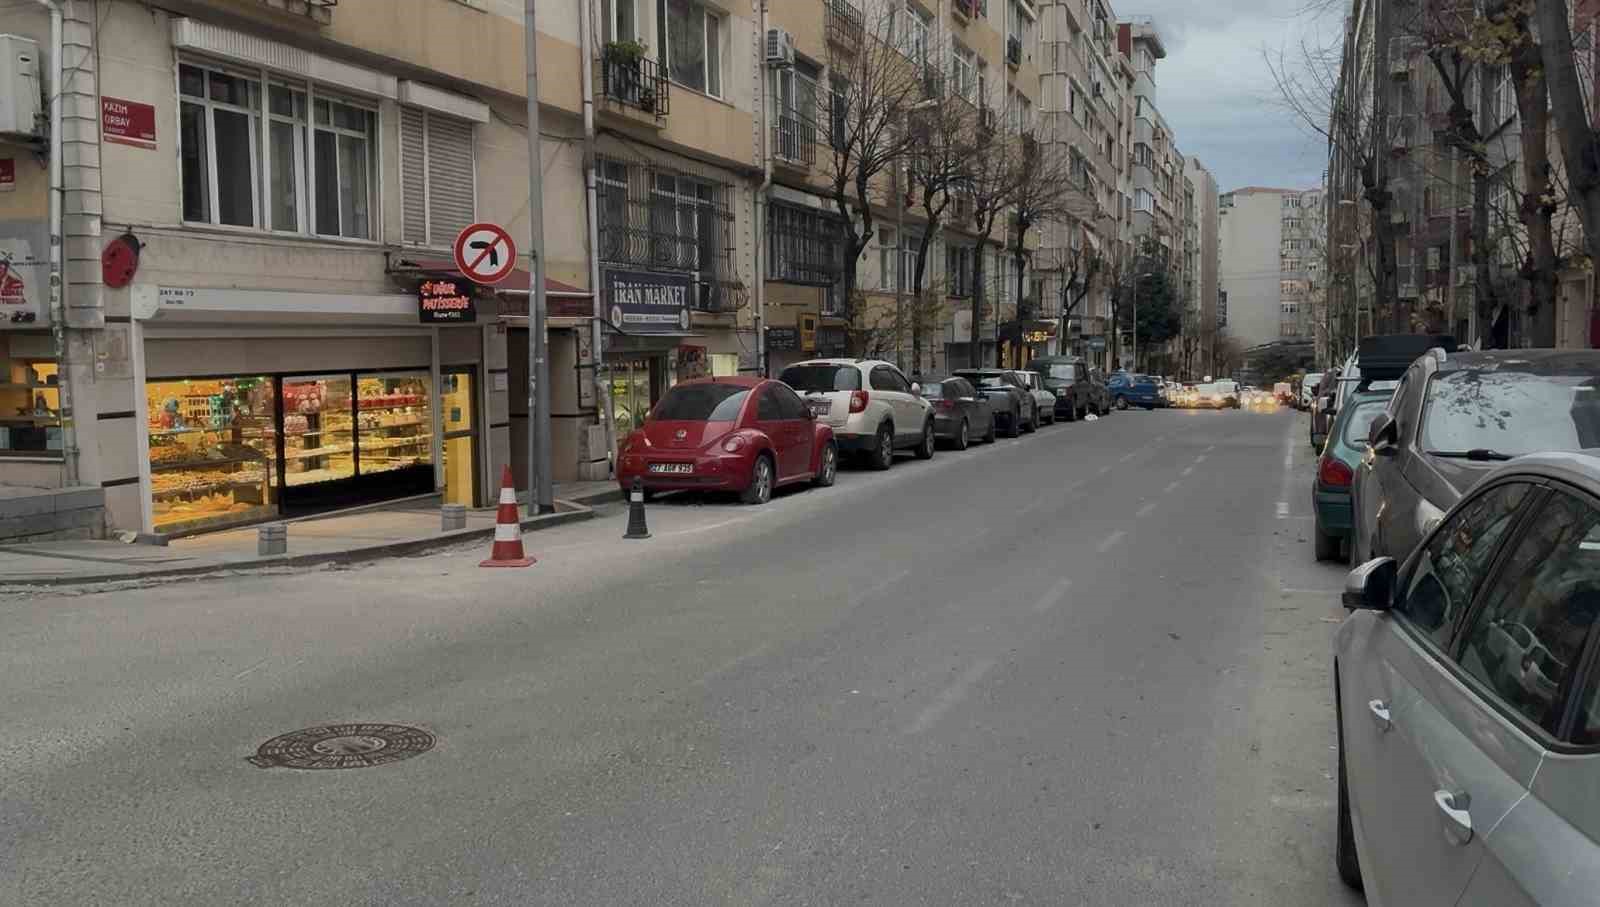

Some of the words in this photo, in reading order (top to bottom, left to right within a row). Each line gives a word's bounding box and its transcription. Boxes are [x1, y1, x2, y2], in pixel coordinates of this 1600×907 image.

[104, 102, 128, 114] KAZIM
[104, 114, 130, 127] ORBAY
[645, 283, 687, 306] MARKET
